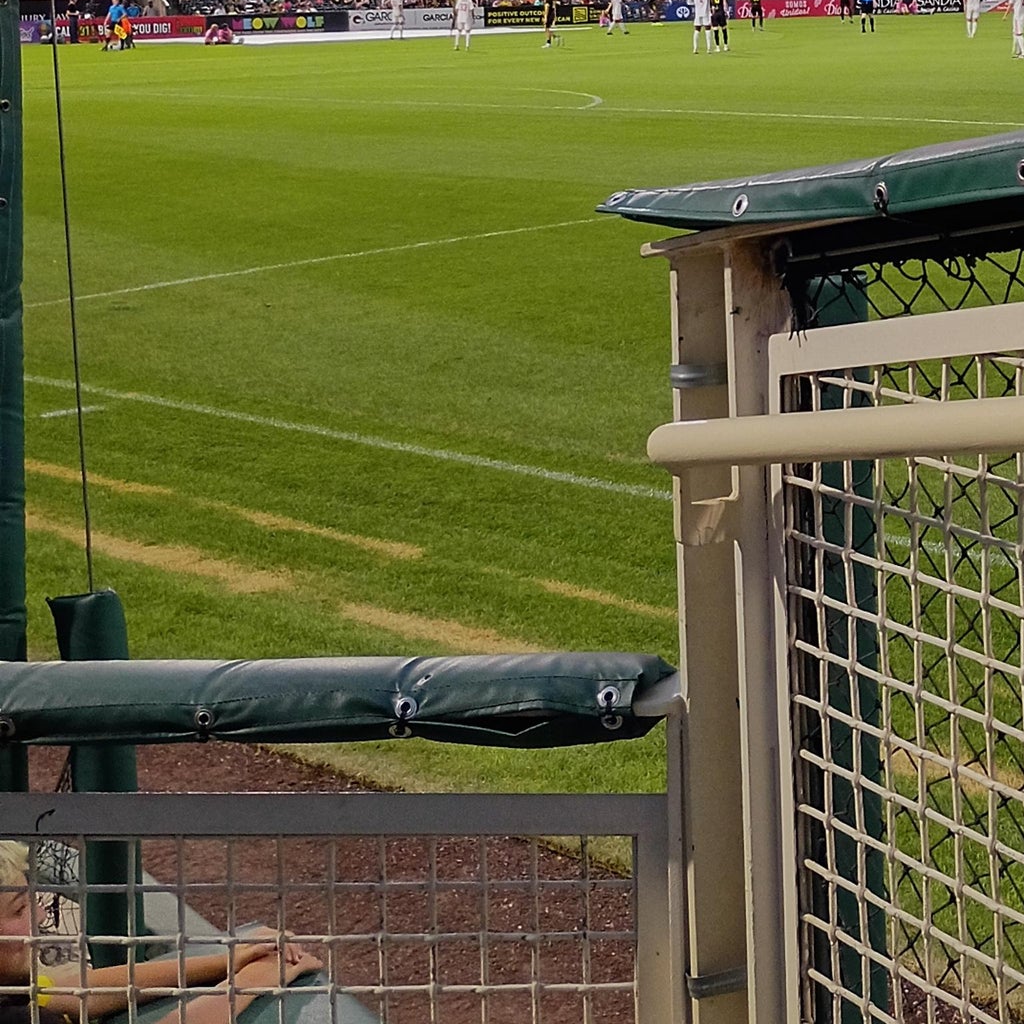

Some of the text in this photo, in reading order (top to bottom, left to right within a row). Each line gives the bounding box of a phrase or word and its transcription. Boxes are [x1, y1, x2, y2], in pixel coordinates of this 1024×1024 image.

[153, 22, 171, 34] DIG!
[232, 15, 325, 30] MEOW WOLF
